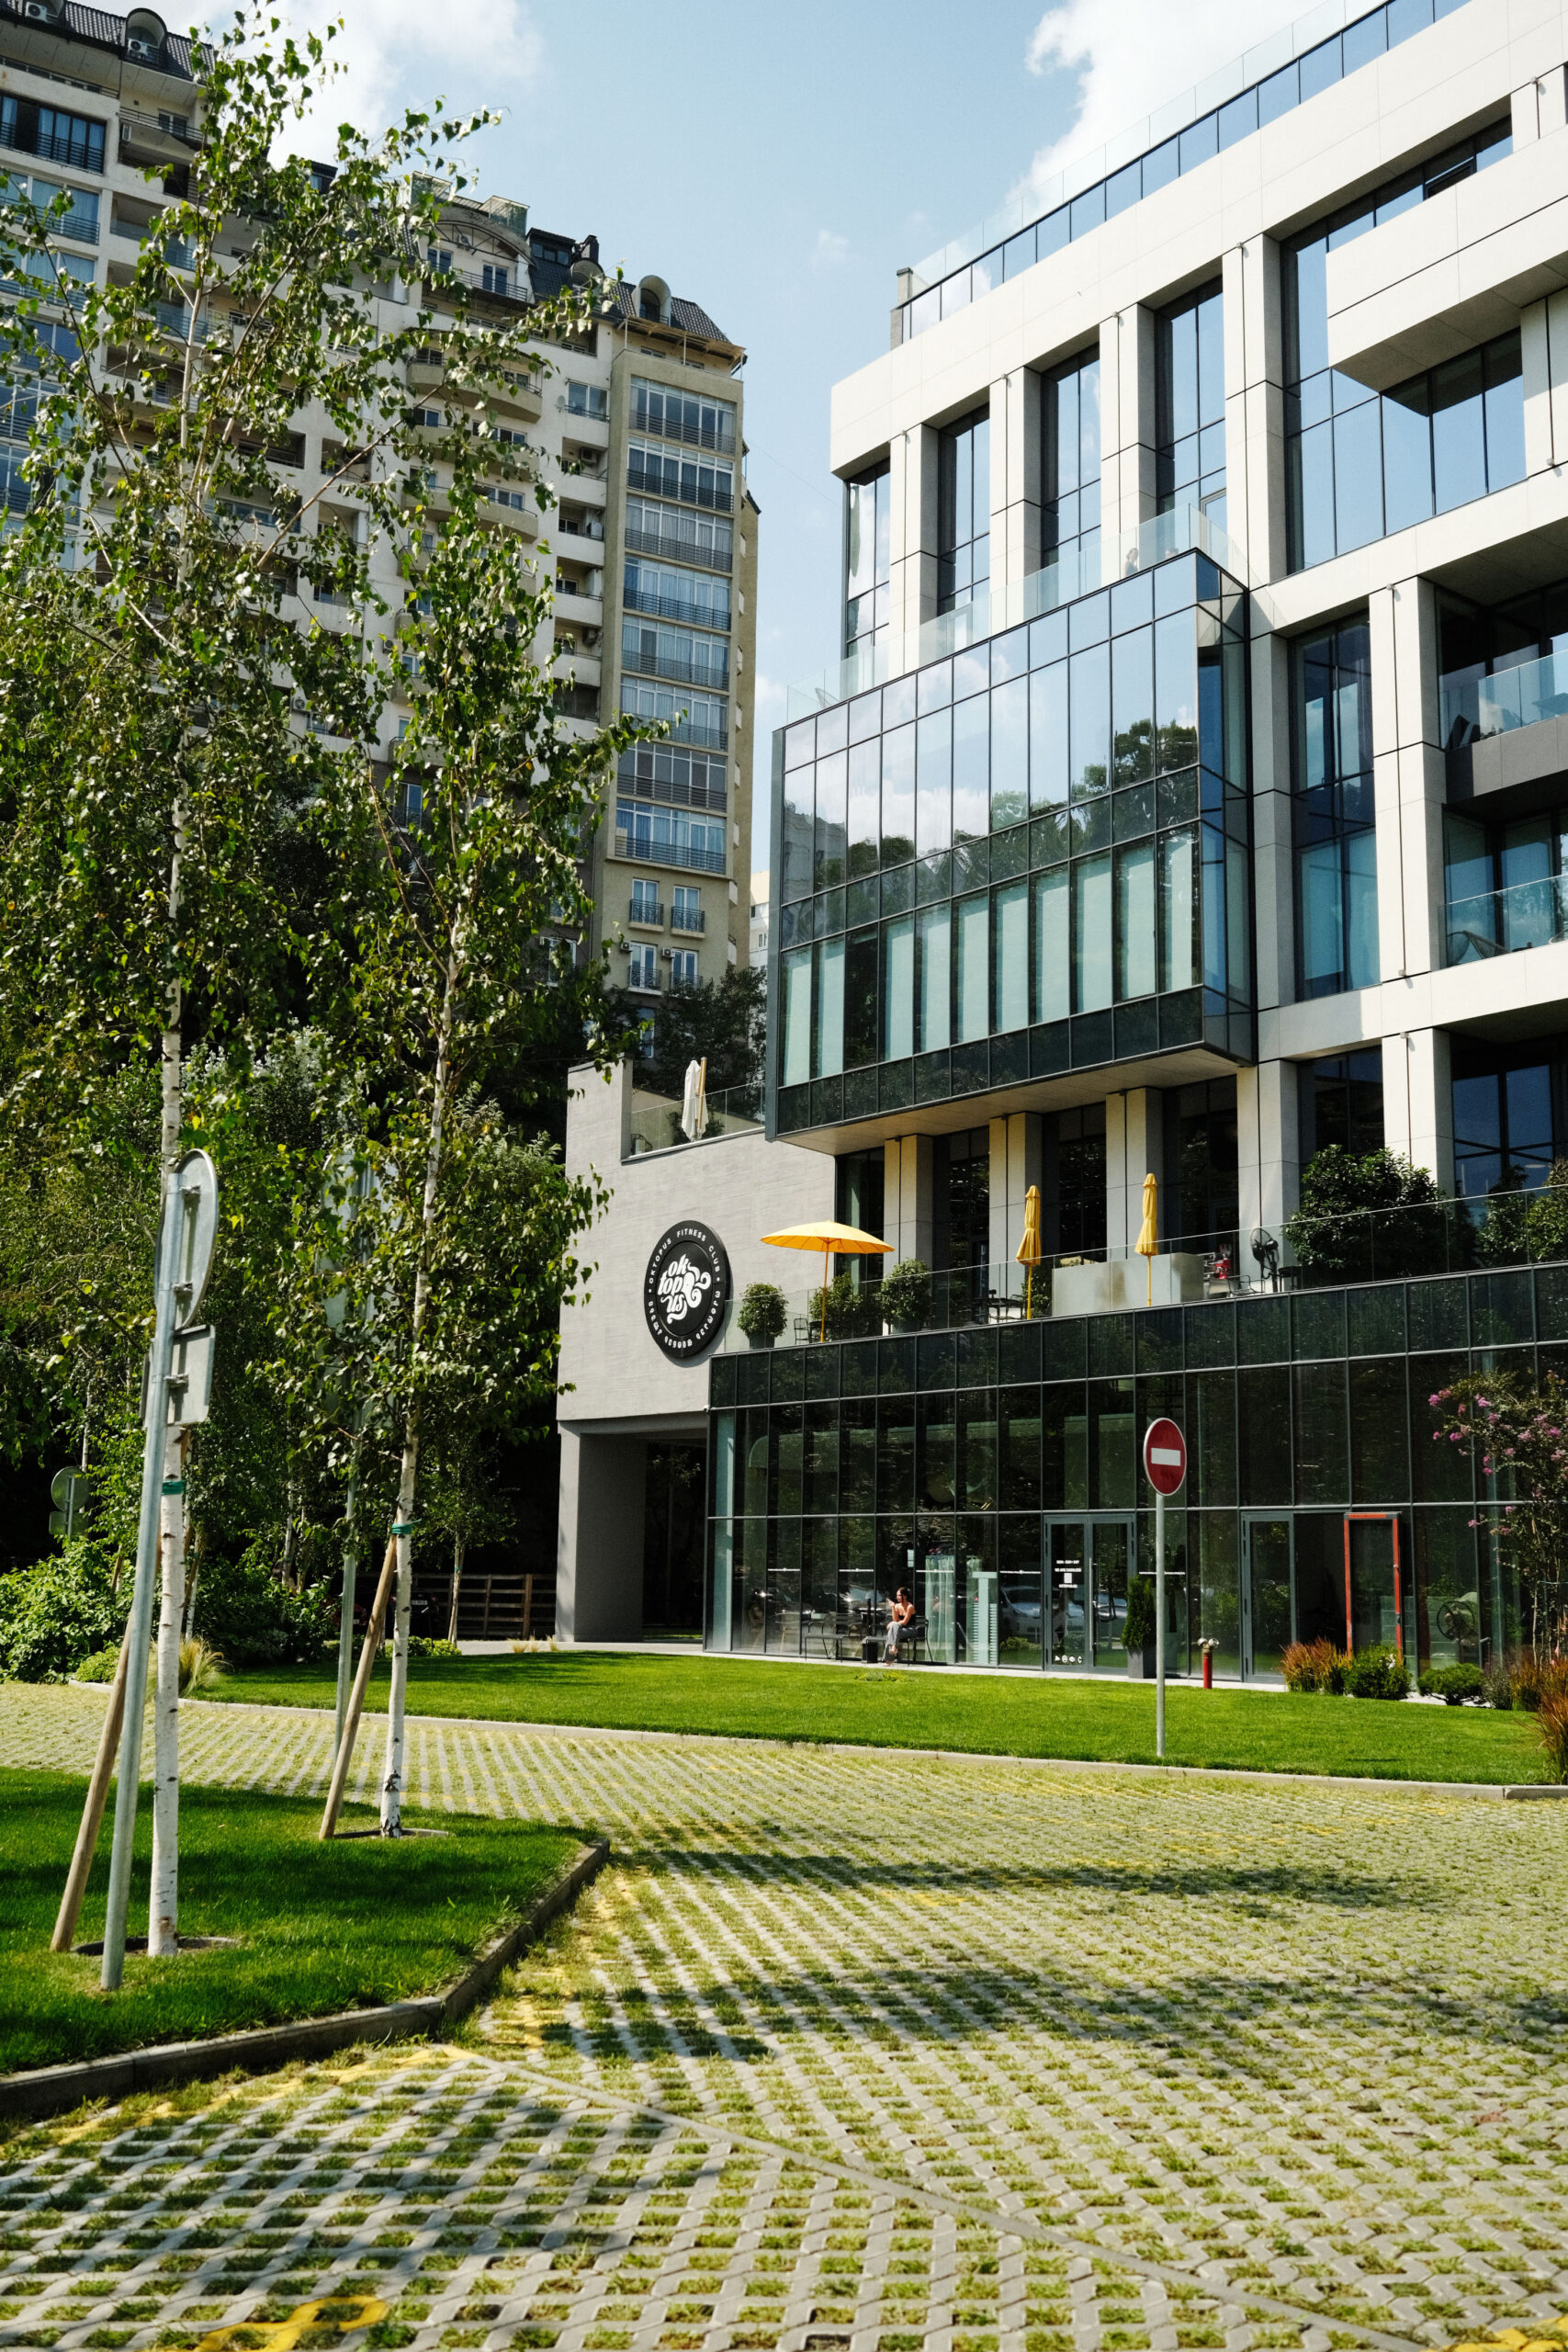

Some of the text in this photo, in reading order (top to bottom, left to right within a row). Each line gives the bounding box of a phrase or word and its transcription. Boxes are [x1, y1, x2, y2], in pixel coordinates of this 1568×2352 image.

[649, 1227, 721, 1284] OKTOPUS FITNESS CLUB
[668, 1253, 690, 1277] ok
[657, 1270, 683, 1296] top
